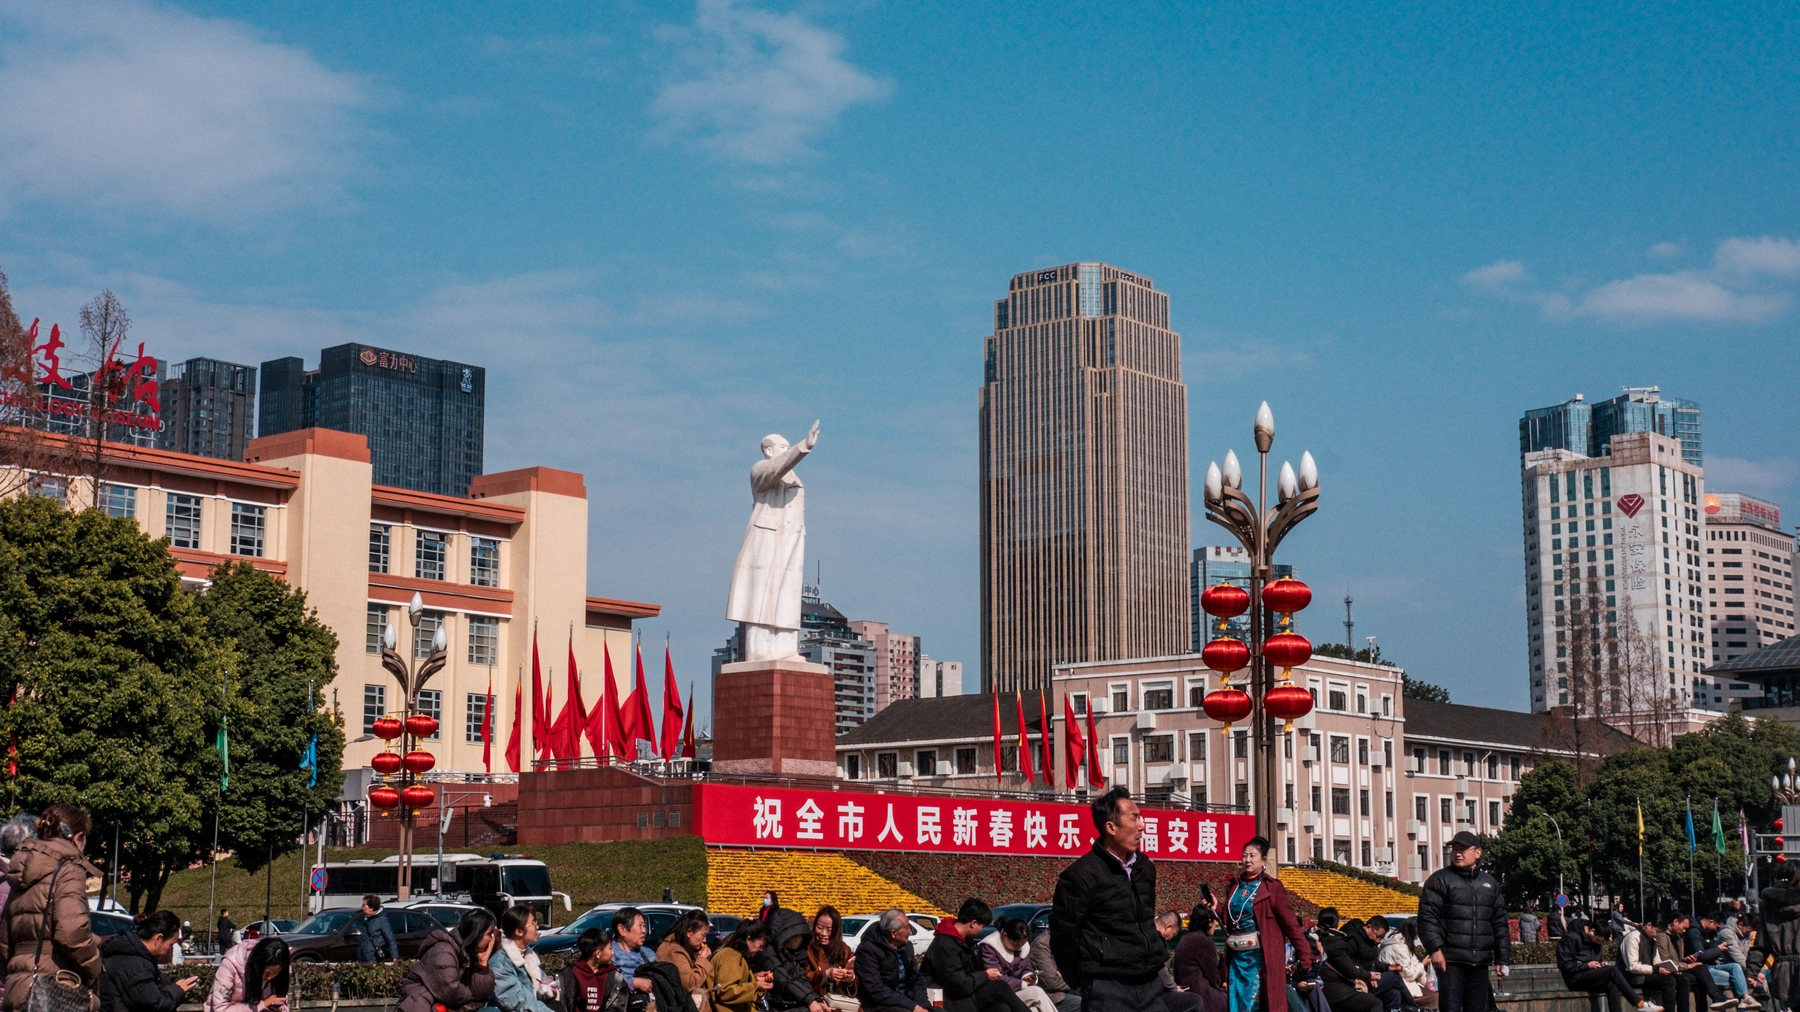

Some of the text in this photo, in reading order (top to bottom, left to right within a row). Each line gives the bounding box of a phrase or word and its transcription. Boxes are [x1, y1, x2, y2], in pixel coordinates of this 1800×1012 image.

[1039, 271, 1056, 281] FCC
[379, 352, 417, 374] 富力中心
[1629, 525, 1646, 591] 永安保险
[802, 584, 819, 596] 中心
[753, 796, 1230, 854] 祝全市人民新春快乐、福安康！
